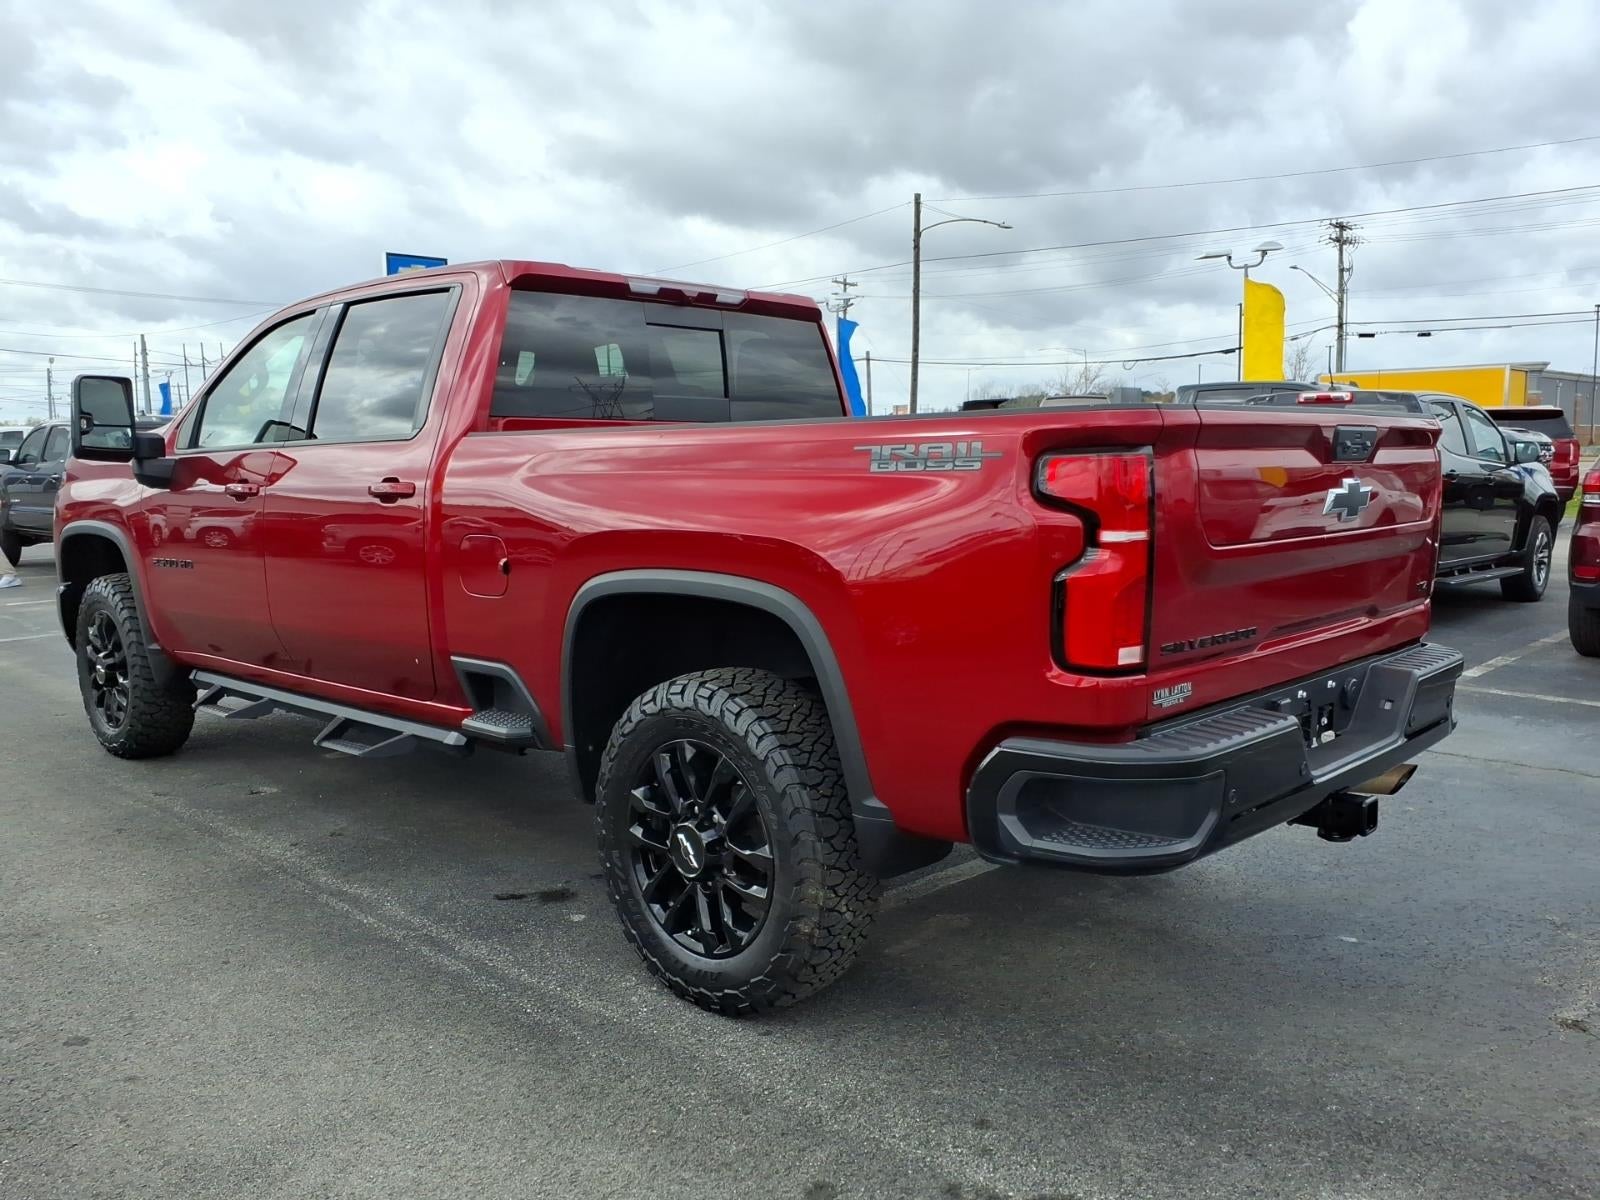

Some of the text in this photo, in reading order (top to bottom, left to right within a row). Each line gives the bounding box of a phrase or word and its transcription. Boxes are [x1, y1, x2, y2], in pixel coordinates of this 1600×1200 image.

[853, 441, 1003, 461] TRAIL
[869, 458, 983, 473] BOSS
[1153, 687, 1170, 700] LYNN
